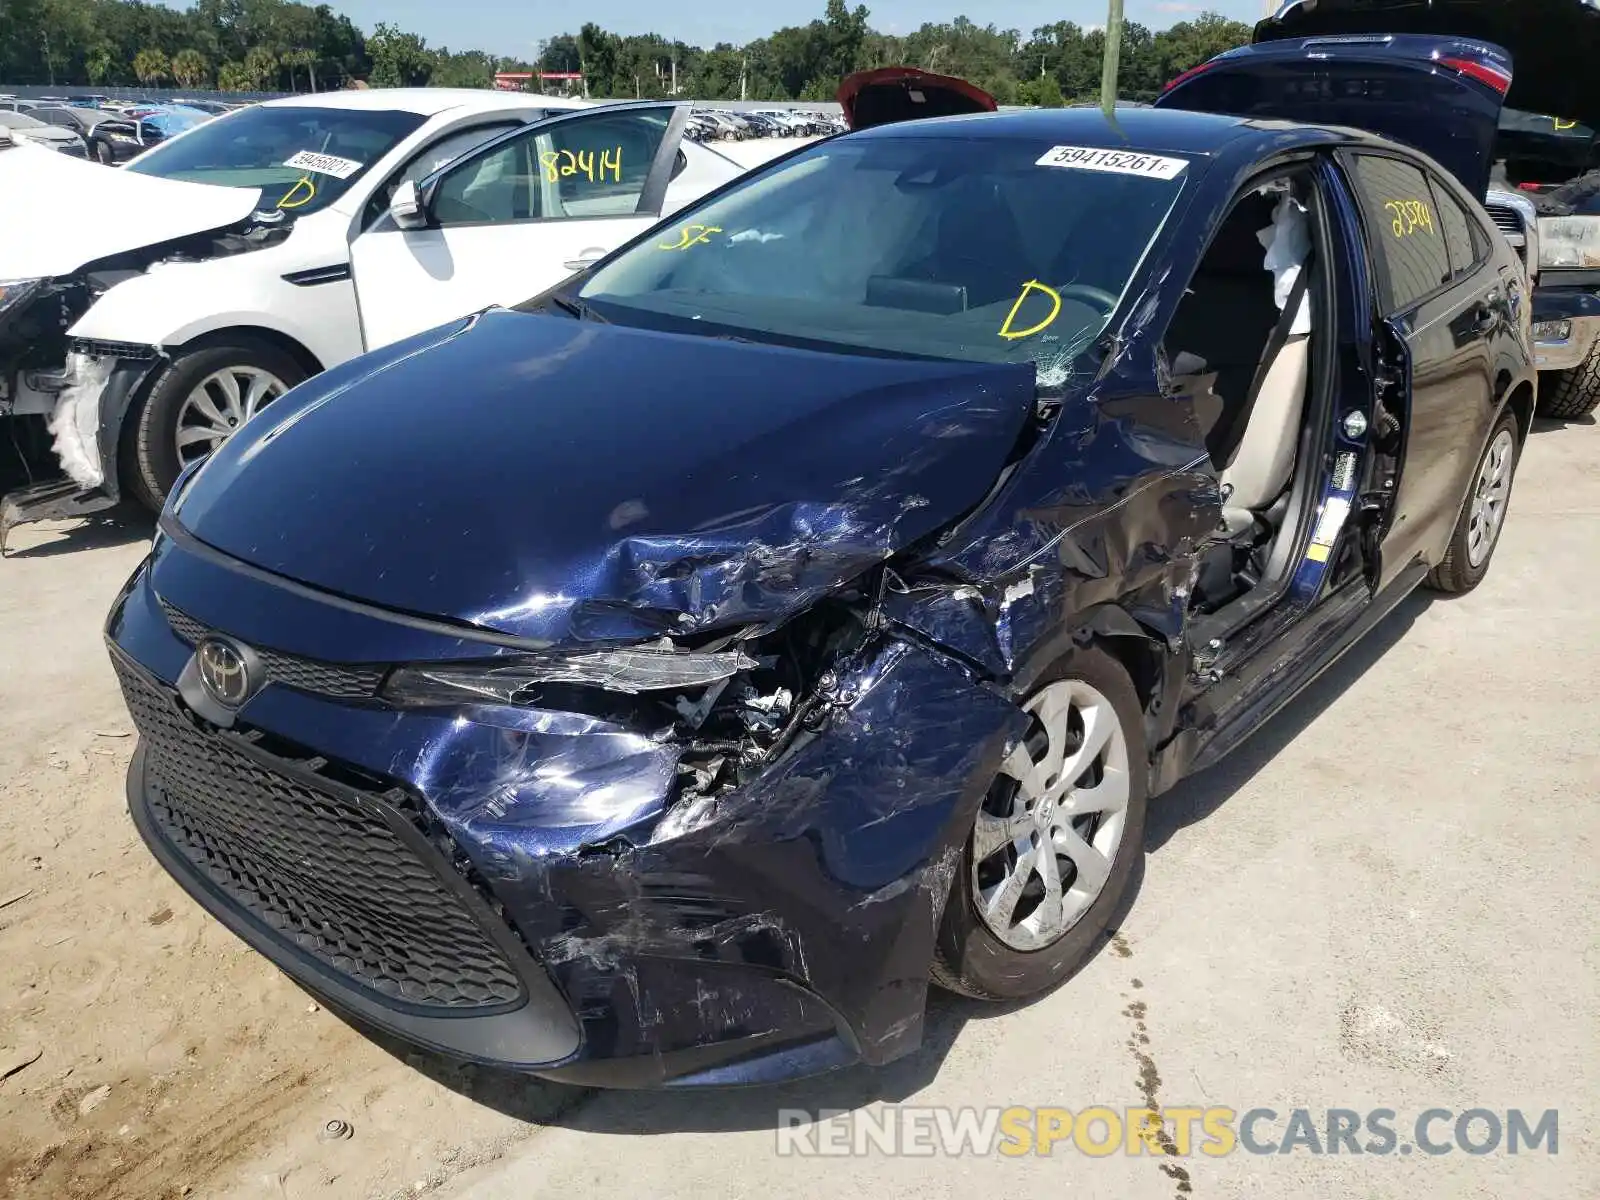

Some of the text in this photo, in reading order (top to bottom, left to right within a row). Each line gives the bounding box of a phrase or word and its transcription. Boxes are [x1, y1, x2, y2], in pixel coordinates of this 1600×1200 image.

[540, 146, 622, 183] 82414
[276, 177, 316, 208] D
[1384, 200, 1434, 238] 23584
[998, 279, 1062, 340] D
